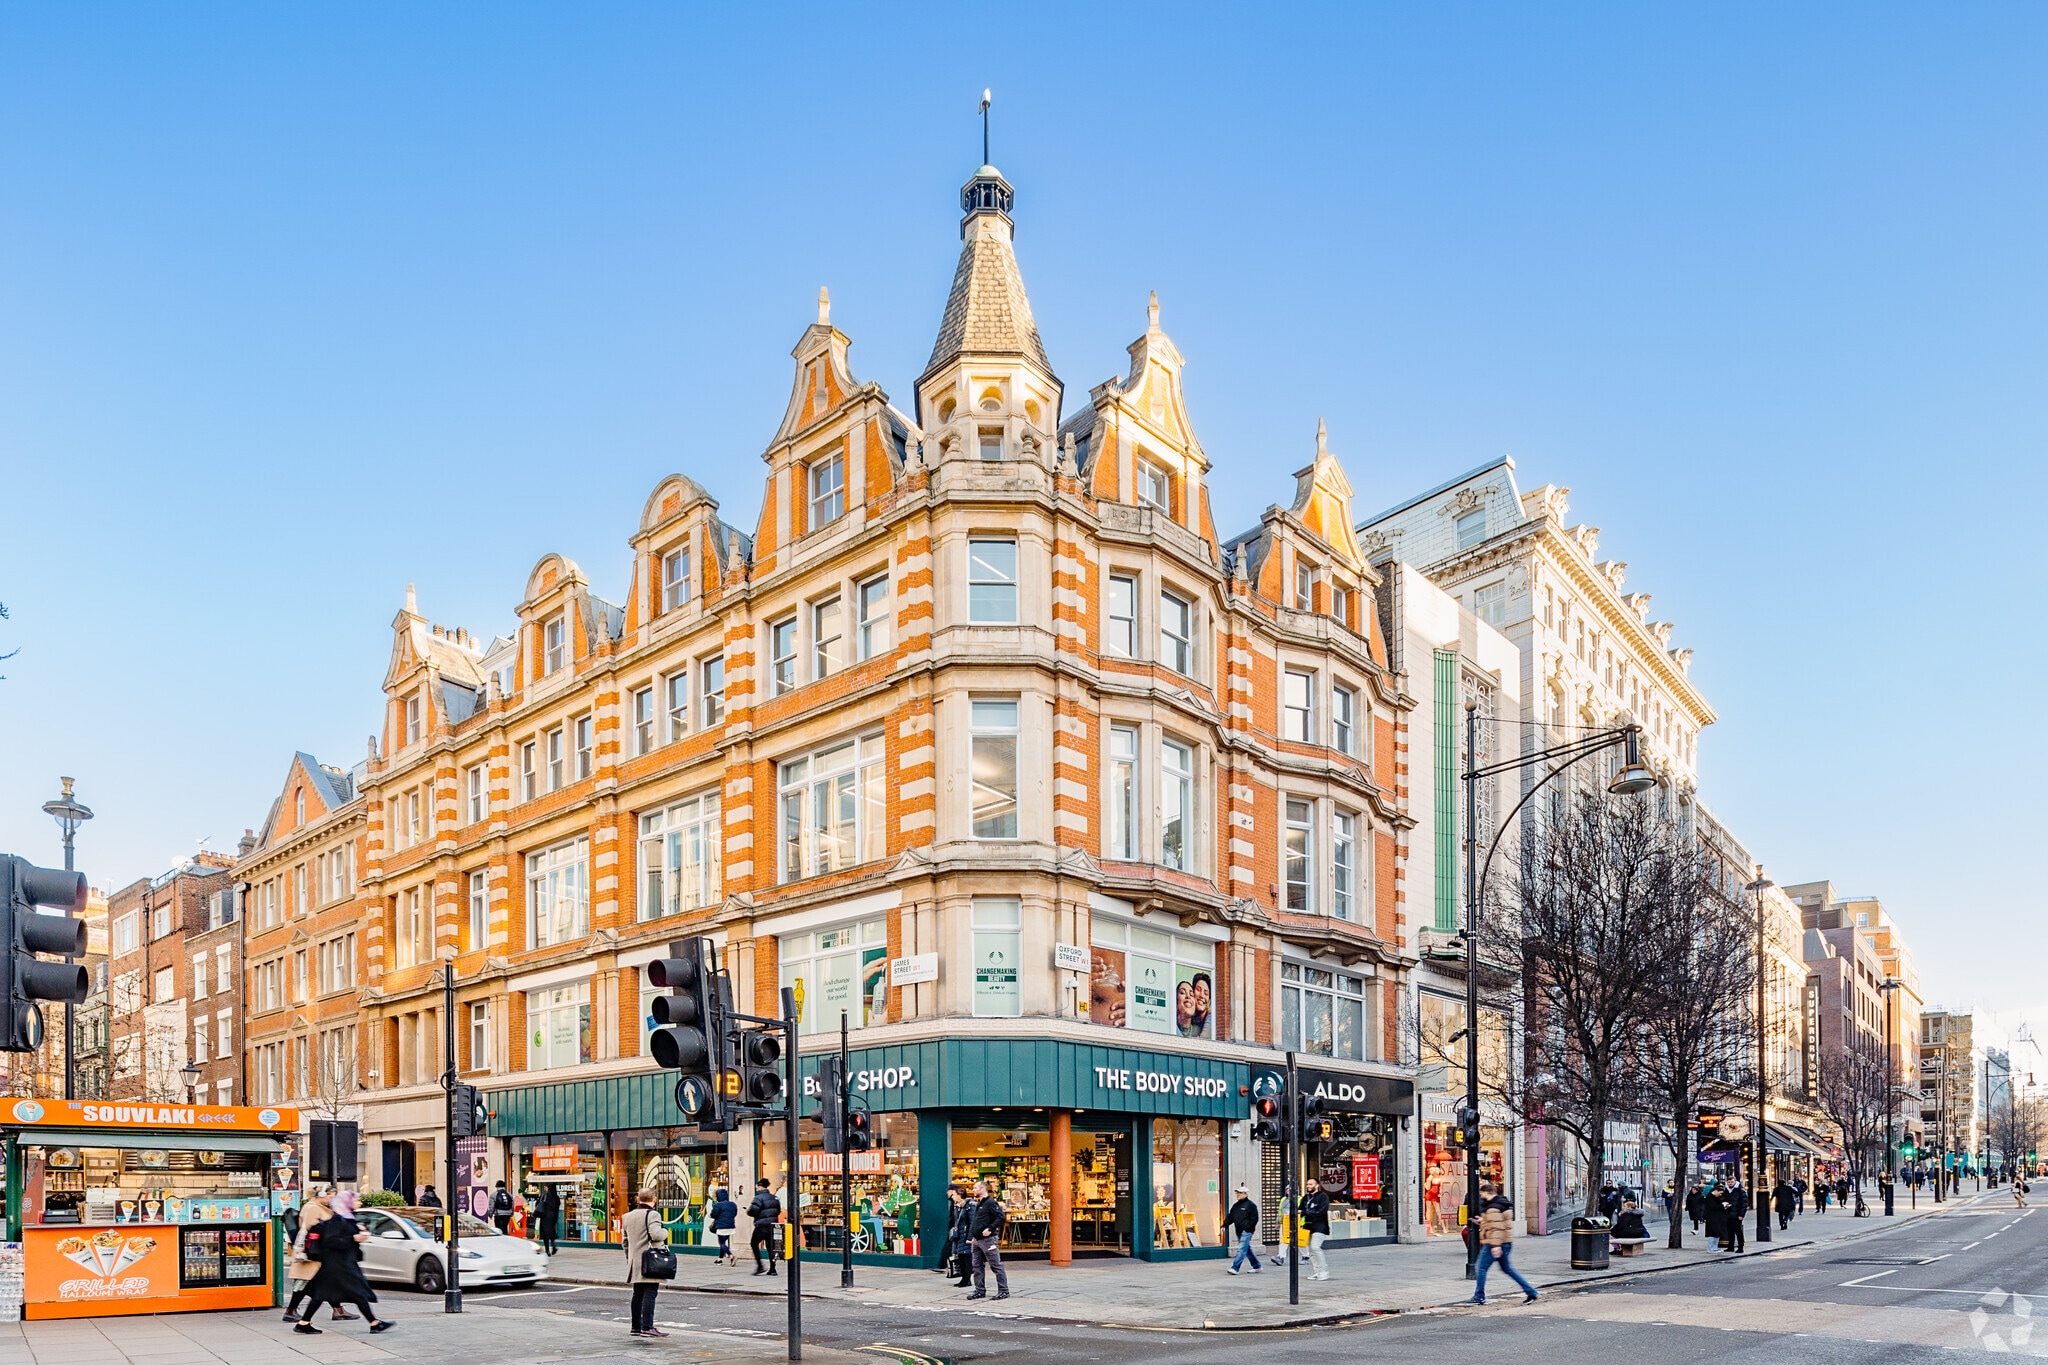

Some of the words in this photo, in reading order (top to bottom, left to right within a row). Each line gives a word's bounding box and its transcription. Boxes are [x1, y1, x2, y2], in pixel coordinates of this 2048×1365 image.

[1058, 945, 1083, 957] OXFORD
[1058, 952, 1080, 963] STREET
[893, 958, 910, 967] JAMES
[893, 965, 912, 975] STREET
[976, 967, 1017, 975] CHANGEMAKING
[1135, 985, 1166, 999] CHANGEMAKING
[1808, 990, 1816, 1062] SUPERDRY
[1095, 1066, 1131, 1090] THE
[1135, 1071, 1181, 1094] BODY
[1313, 1081, 1366, 1103] ALDO
[67, 1102, 82, 1110] THE
[83, 1105, 195, 1124] SOUVLAKI
[197, 1113, 236, 1124] GREEK
[812, 1154, 819, 1172] A
[58, 1276, 150, 1292] GRILLED
[60, 1288, 114, 1299] HALLOUMI
[116, 1287, 148, 1296] WRAP
